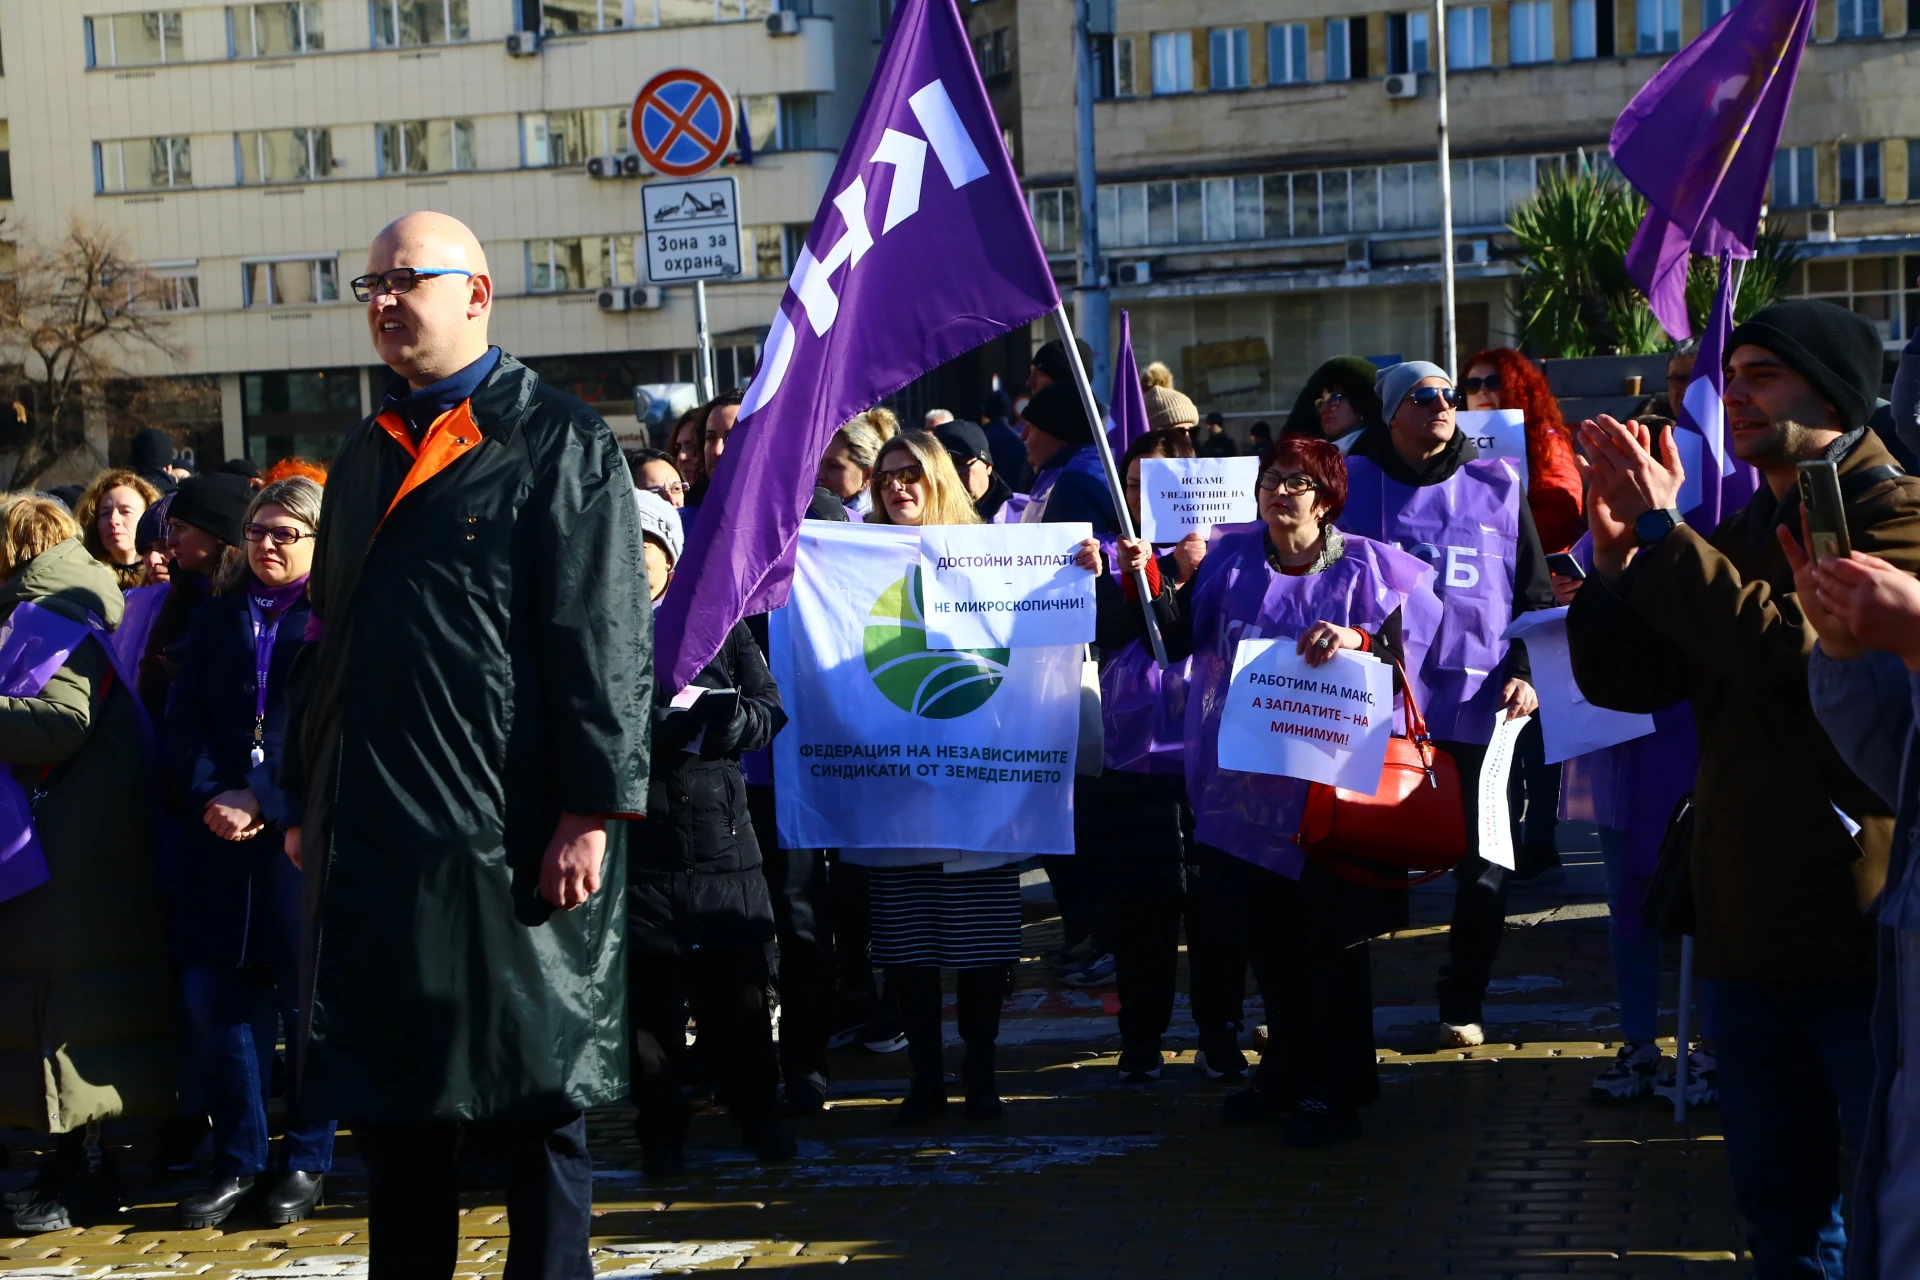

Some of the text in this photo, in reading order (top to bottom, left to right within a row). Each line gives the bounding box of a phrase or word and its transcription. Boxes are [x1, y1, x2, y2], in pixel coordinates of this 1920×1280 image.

[657, 234, 727, 252] Зона за
[664, 254, 723, 274] охрана
[1181, 476, 1225, 485] ИСКАМЕ
[1160, 490, 1245, 499] УВЕЛИЧЕНИЕ НА
[1173, 502, 1233, 512] РАБОТНИТЕ
[1179, 515, 1226, 524] ЗАПЛАТИ
[936, 553, 1013, 570] ДОСТОЙНИ
[934, 597, 1085, 613] НЕ МИКРОСКОПИЧНИ!
[1249, 672, 1376, 707] РАБОТИМ НА МАКС,
[1252, 697, 1261, 708] А
[1264, 697, 1341, 722] ЗАПЛАТИТЕ
[1353, 713, 1369, 728] НА
[1270, 720, 1350, 746] МИНИМУМ!
[800, 743, 1068, 765] ФЕДЕРАЦИЯ НА НЕЗАВИСИМИТЕ
[810, 763, 1061, 784] СИНДИКАТИ ОТ ЗЕМЕДЕЛИЕТО
